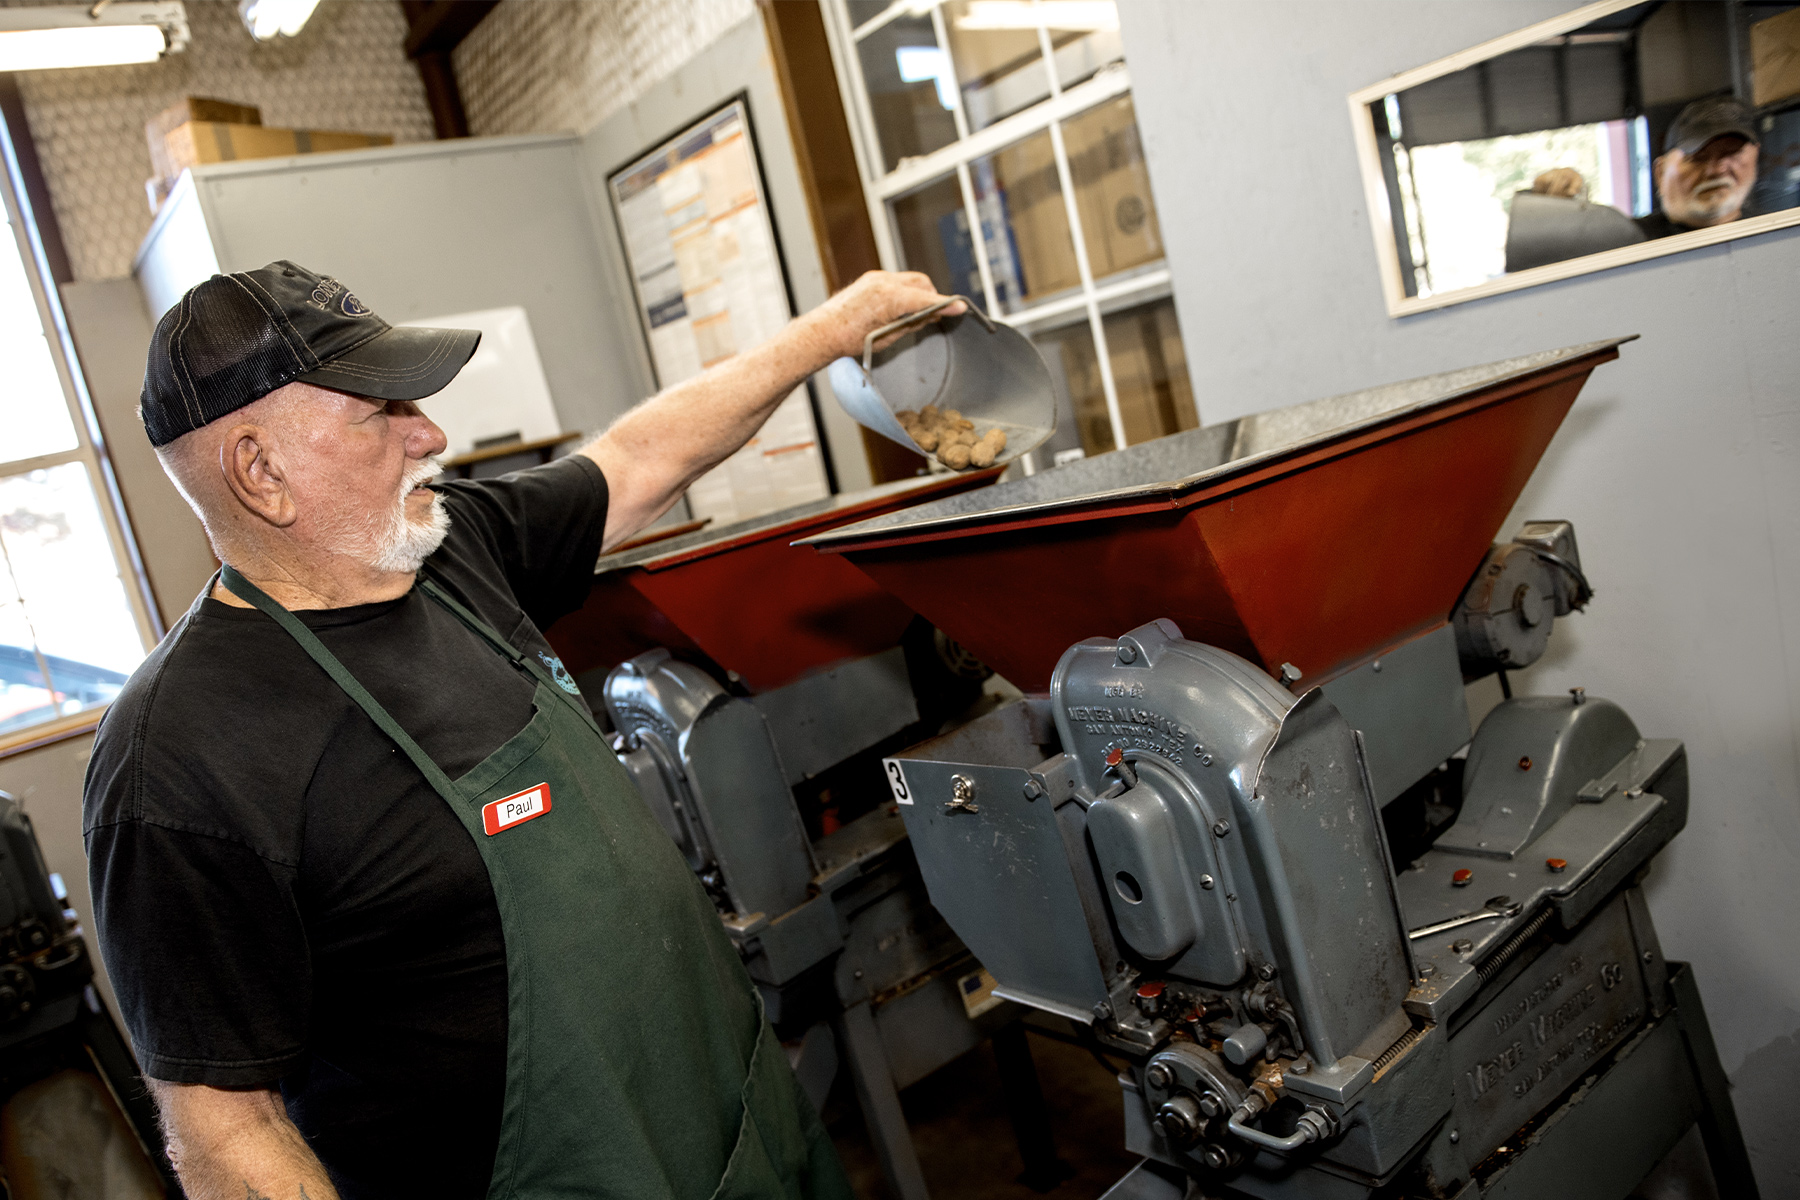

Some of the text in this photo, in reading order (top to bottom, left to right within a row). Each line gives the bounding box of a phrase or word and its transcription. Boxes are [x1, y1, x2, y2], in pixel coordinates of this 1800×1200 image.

[1068, 706, 1213, 767] MEYER MACHINE CO
[1085, 724, 1185, 755] SAN ANTONIO TEX
[888, 762, 908, 800] 3
[506, 797, 533, 819] Paul
[1466, 1041, 1526, 1101] MEYER
[1529, 983, 1597, 1049] MACHINE
